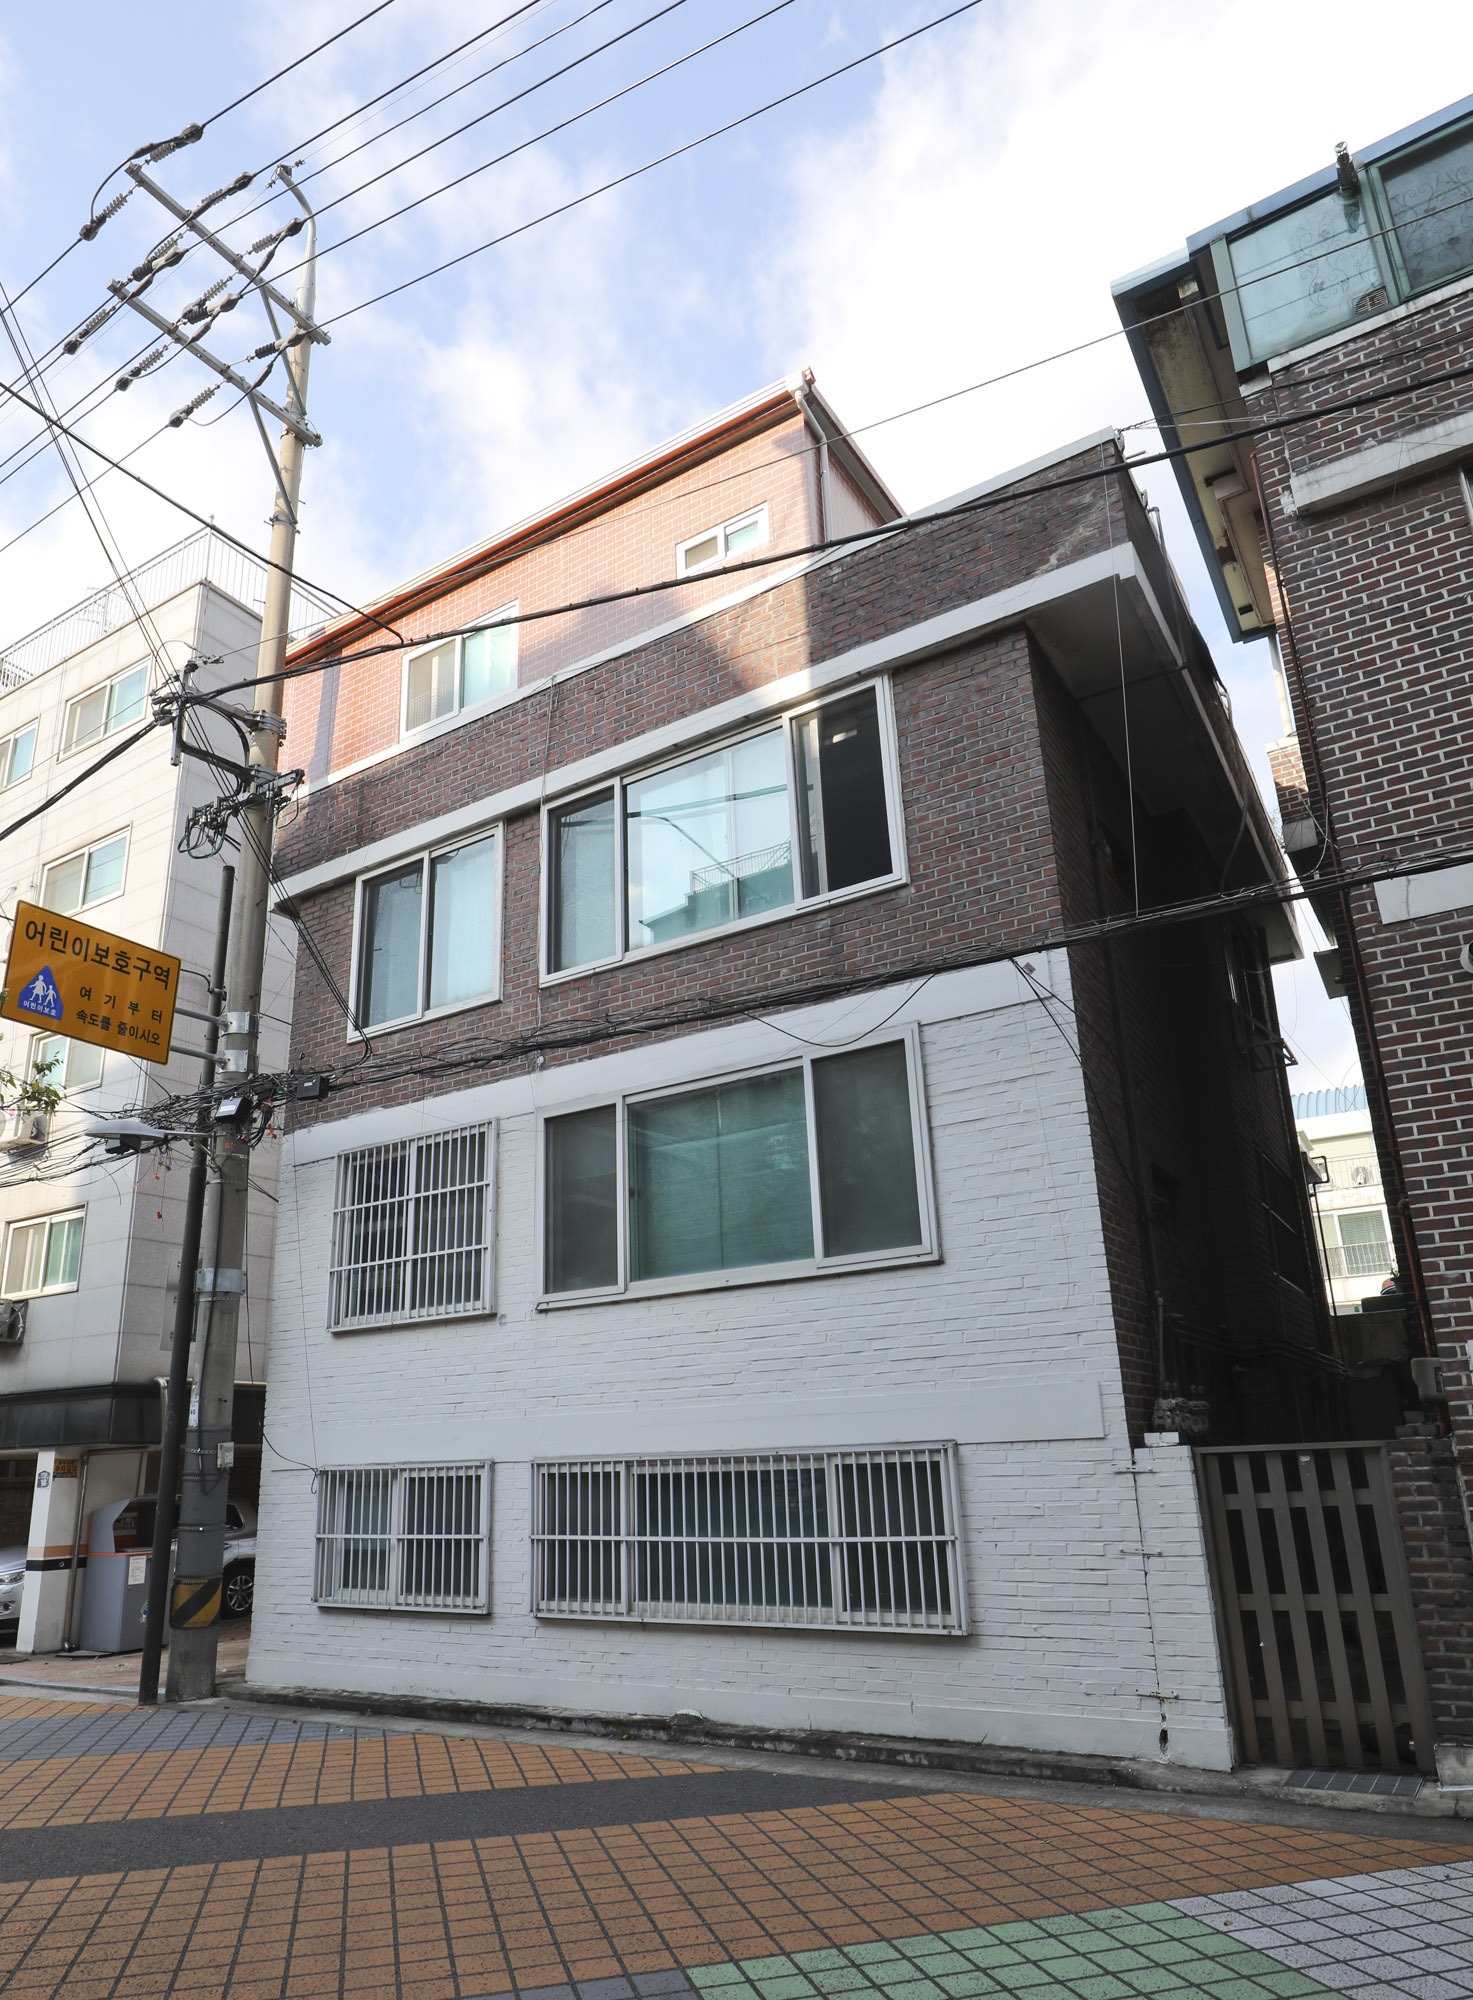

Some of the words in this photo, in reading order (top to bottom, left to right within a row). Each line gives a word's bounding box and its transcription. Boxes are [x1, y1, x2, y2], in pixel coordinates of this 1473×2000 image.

[25, 920, 170, 991] 어린이보호구역
[23, 1000, 57, 1017] 어린이보호
[76, 1009, 111, 1031] 속도를
[117, 1021, 160, 1045] 줄이시오
